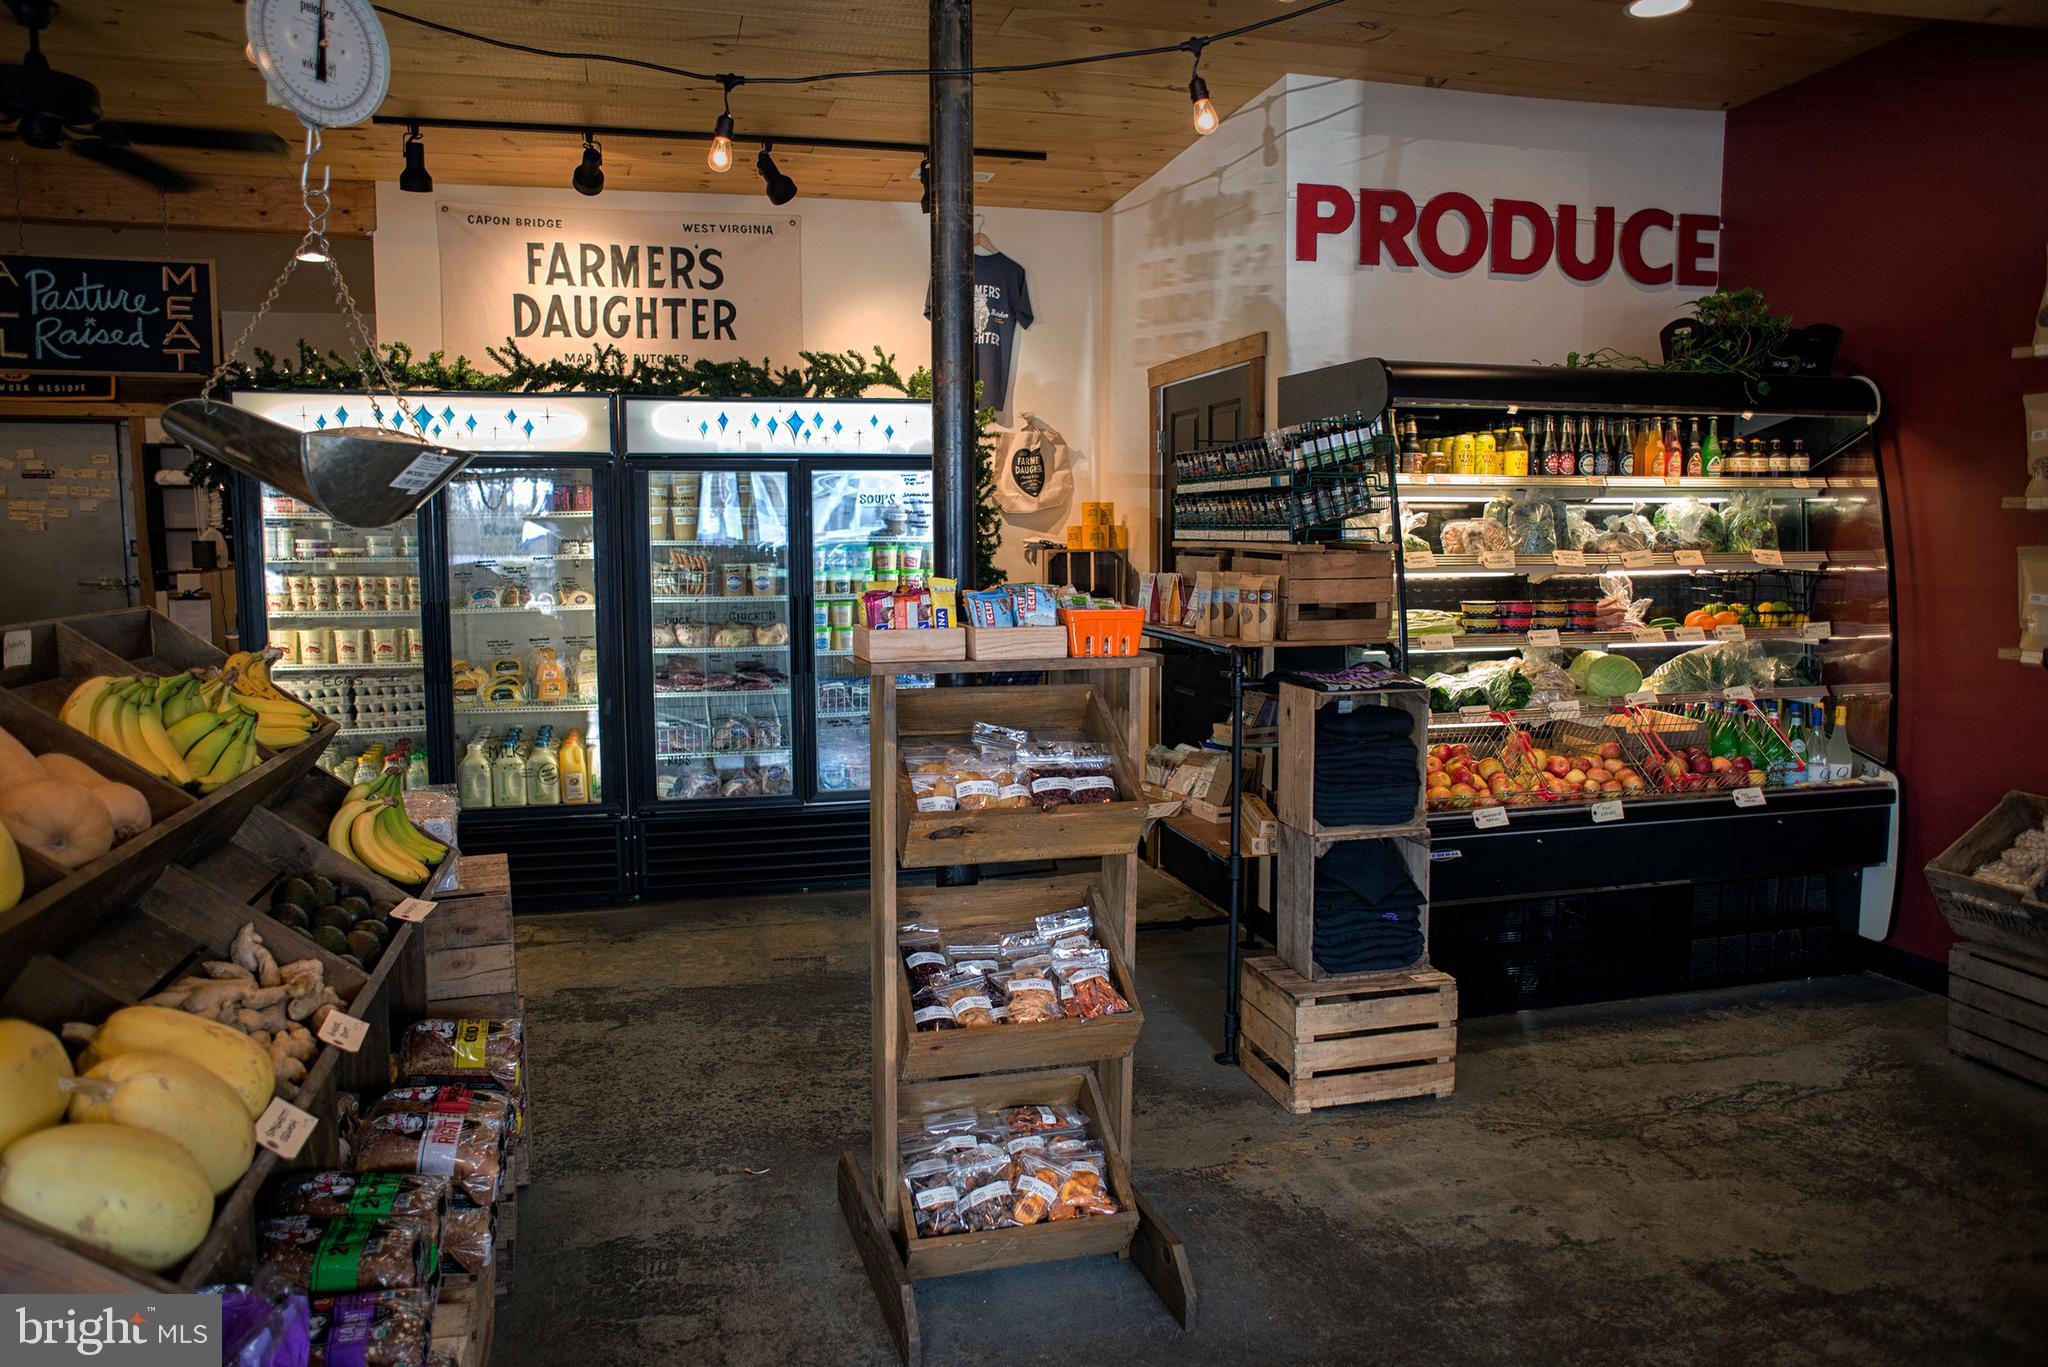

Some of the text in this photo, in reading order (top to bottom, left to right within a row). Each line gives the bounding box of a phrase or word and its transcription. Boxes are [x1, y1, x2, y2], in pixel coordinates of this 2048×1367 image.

[300, 2, 335, 21] peloze
[467, 214, 563, 229] CAPON BRIDGE
[682, 223, 774, 235] WEST VIRGINIA
[1297, 182, 1722, 287] PRODUCE
[526, 241, 725, 291] FARMER'S
[25, 269, 160, 316] Pasture
[161, 265, 201, 372] MEAT
[512, 293, 737, 340] DAUGHTER
[35, 316, 151, 360] Raised
[859, 493, 896, 505] SOUPS
[322, 676, 364, 688] EGGS
[489, 745, 526, 759] MILK
[1836, 767, 1848, 779] Q
